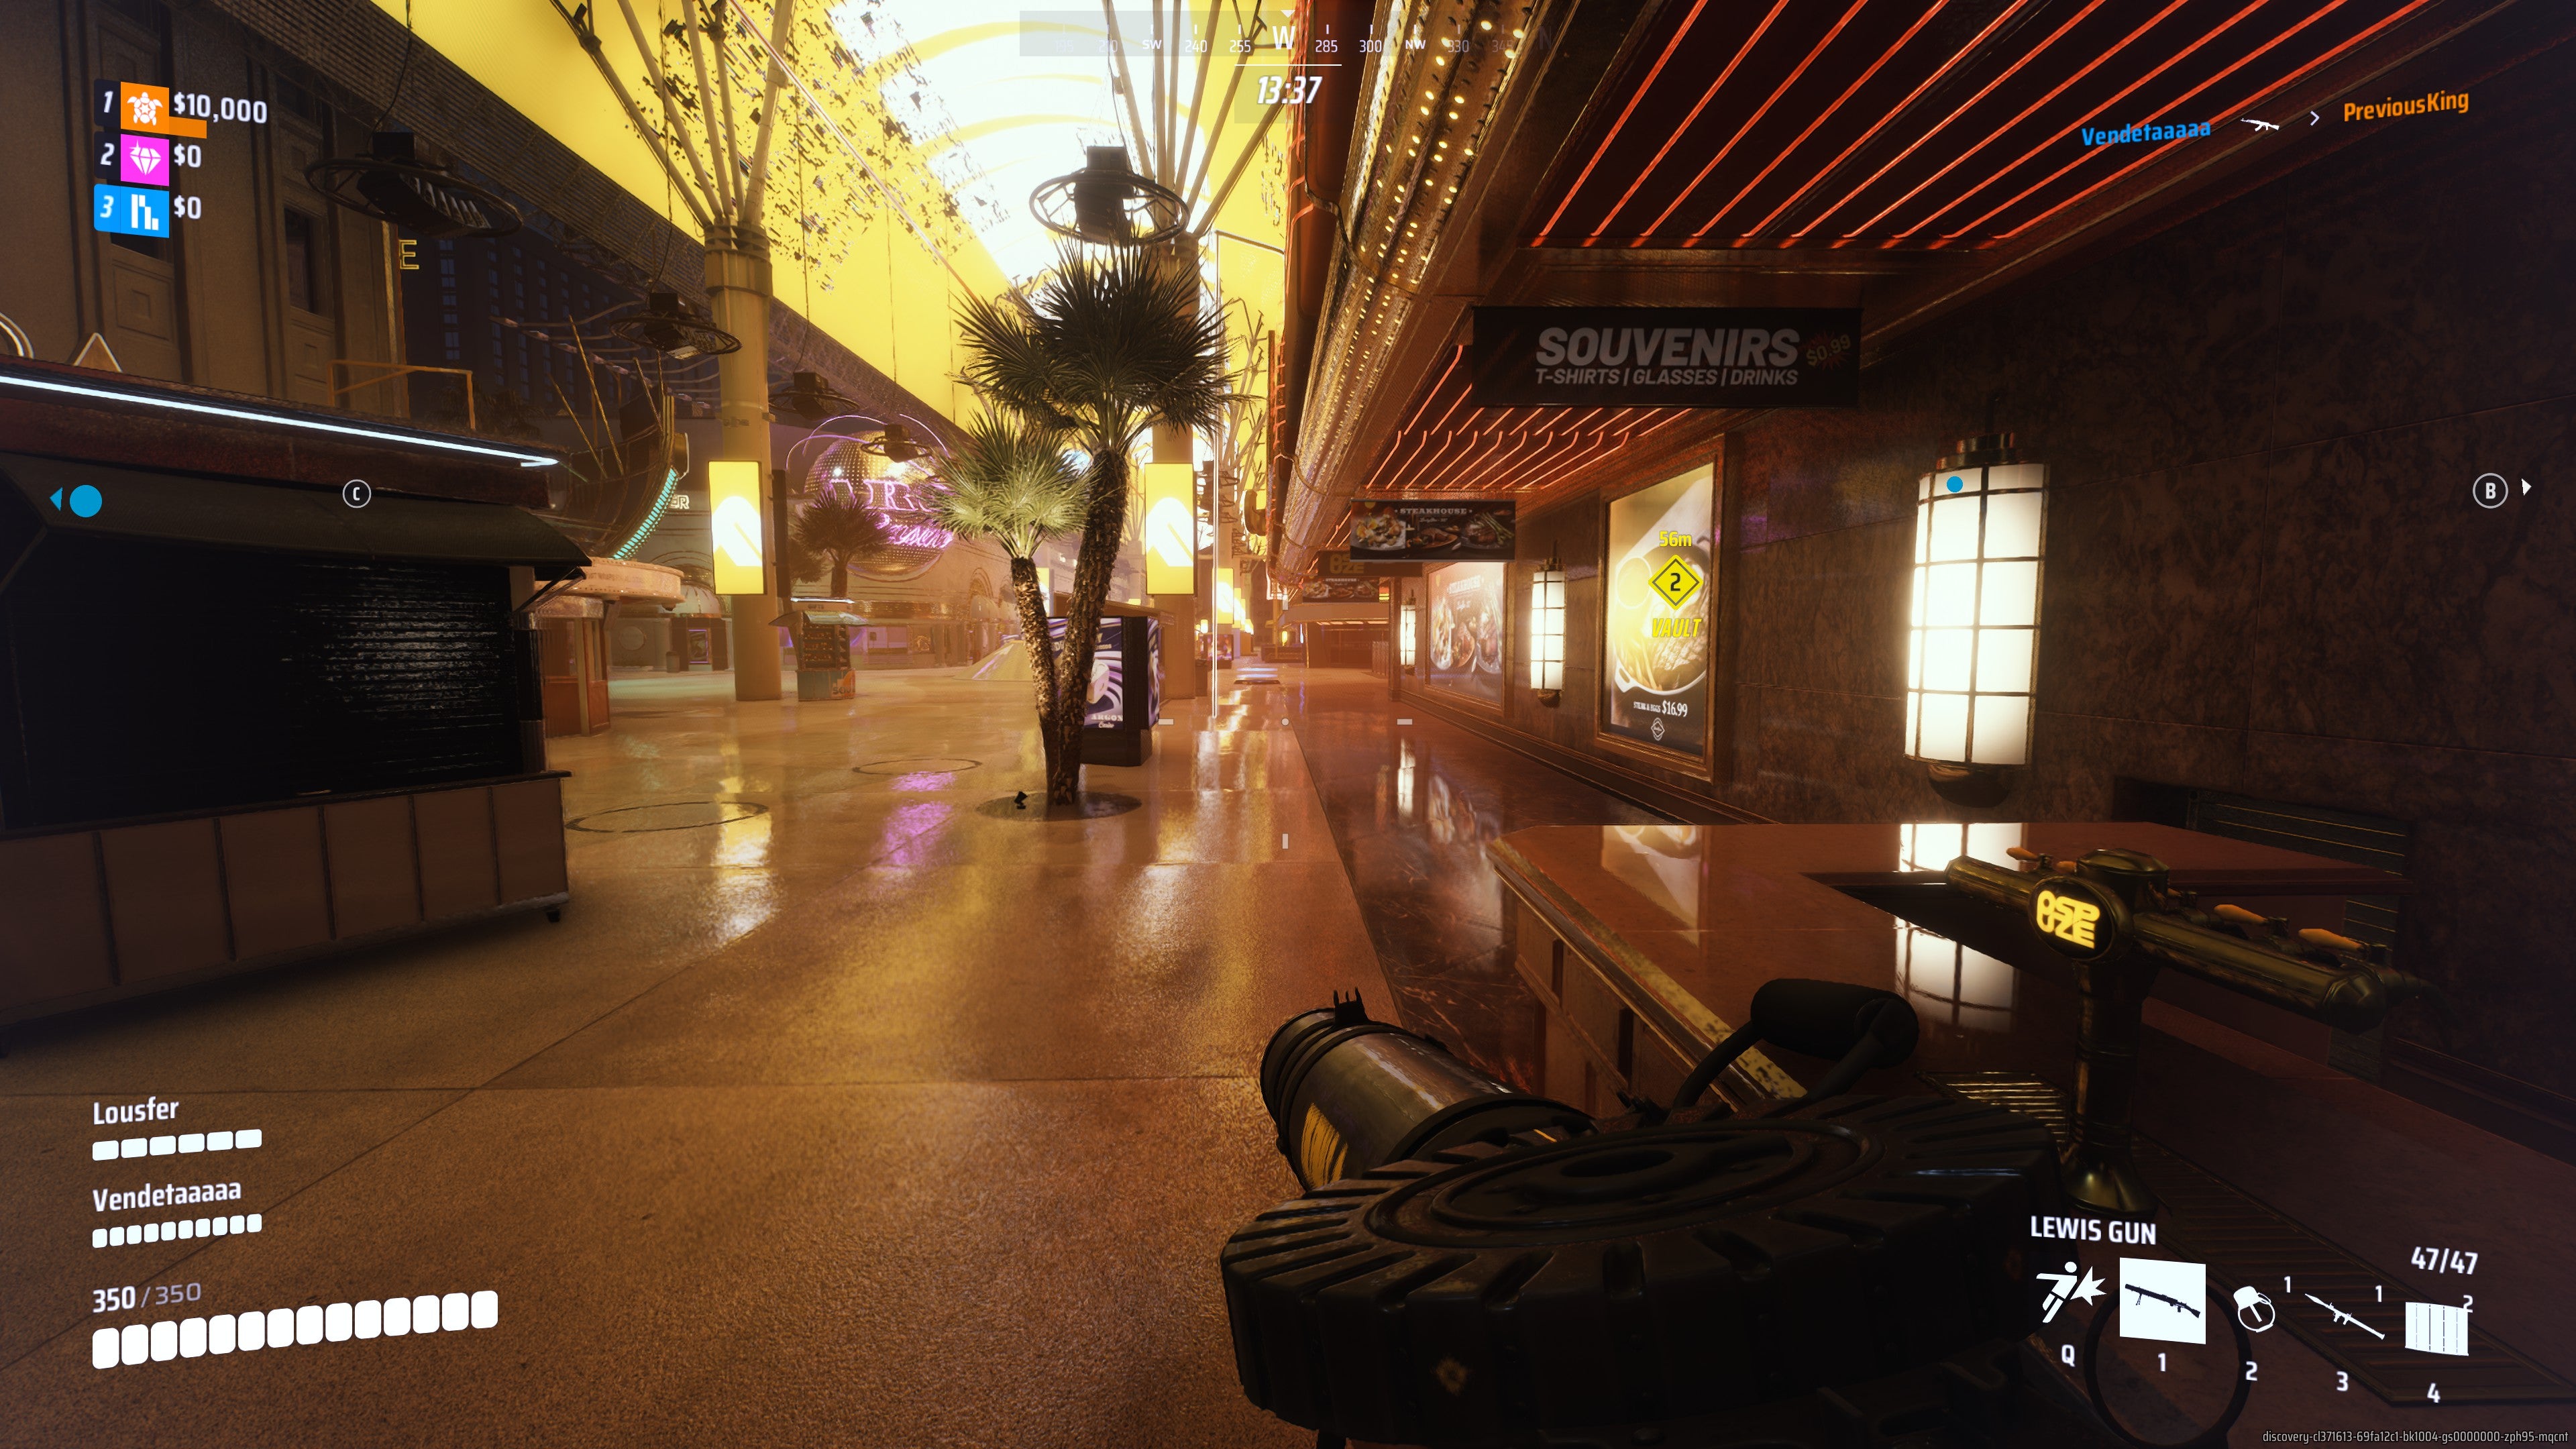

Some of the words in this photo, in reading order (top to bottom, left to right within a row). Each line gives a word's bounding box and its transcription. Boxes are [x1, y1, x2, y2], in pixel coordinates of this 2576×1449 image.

[1536, 327, 1801, 367] SOUVENIRS
[1806, 334, 1851, 366] $0.99
[1536, 368, 1620, 384] T-SHIRTS
[1633, 368, 1717, 385] GLASSES
[1731, 369, 1799, 385] DRINKS
[1662, 700, 1688, 717] $16.99
